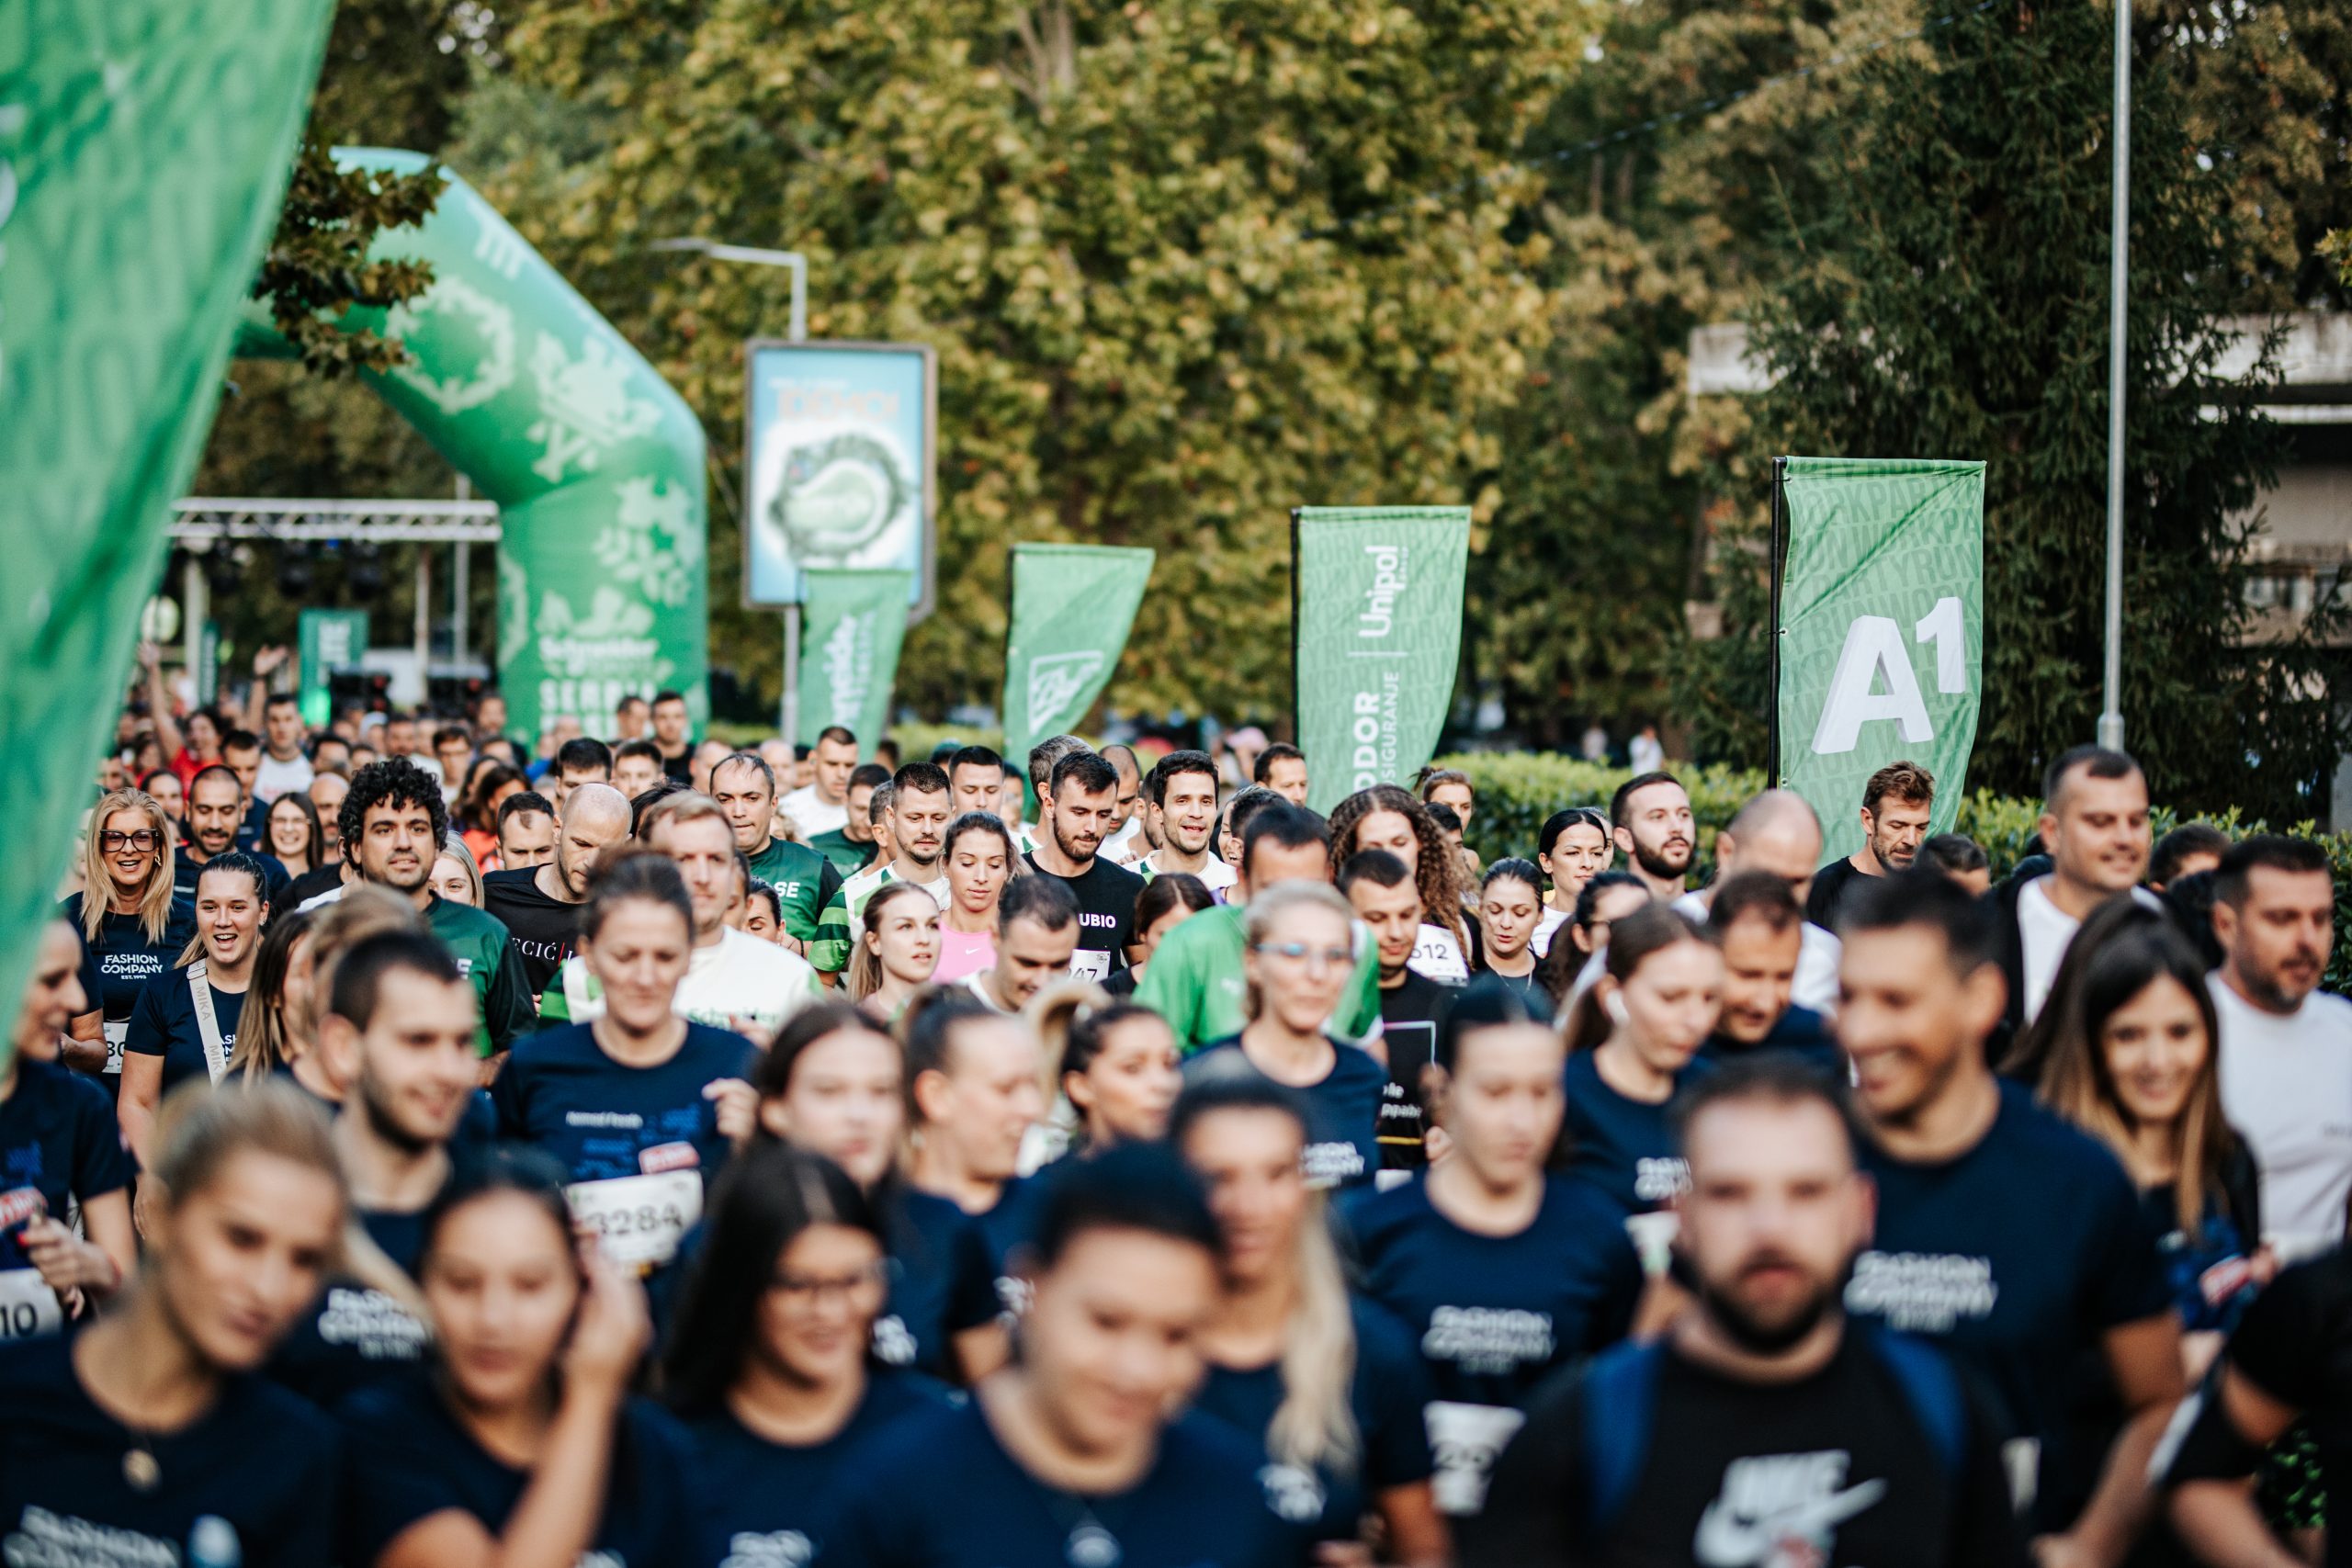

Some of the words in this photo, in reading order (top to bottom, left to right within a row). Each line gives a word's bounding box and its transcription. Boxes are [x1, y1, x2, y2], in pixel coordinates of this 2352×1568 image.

[1358, 545, 1407, 637] Unipol
[1811, 595, 1966, 755] A1
[774, 881, 801, 898] SE
[1079, 913, 1116, 929] UBIO
[105, 953, 159, 964] FASHION
[100, 964, 164, 974] COMPANY
[1067, 967, 1098, 984] 47
[196, 986, 212, 1021] MIKA
